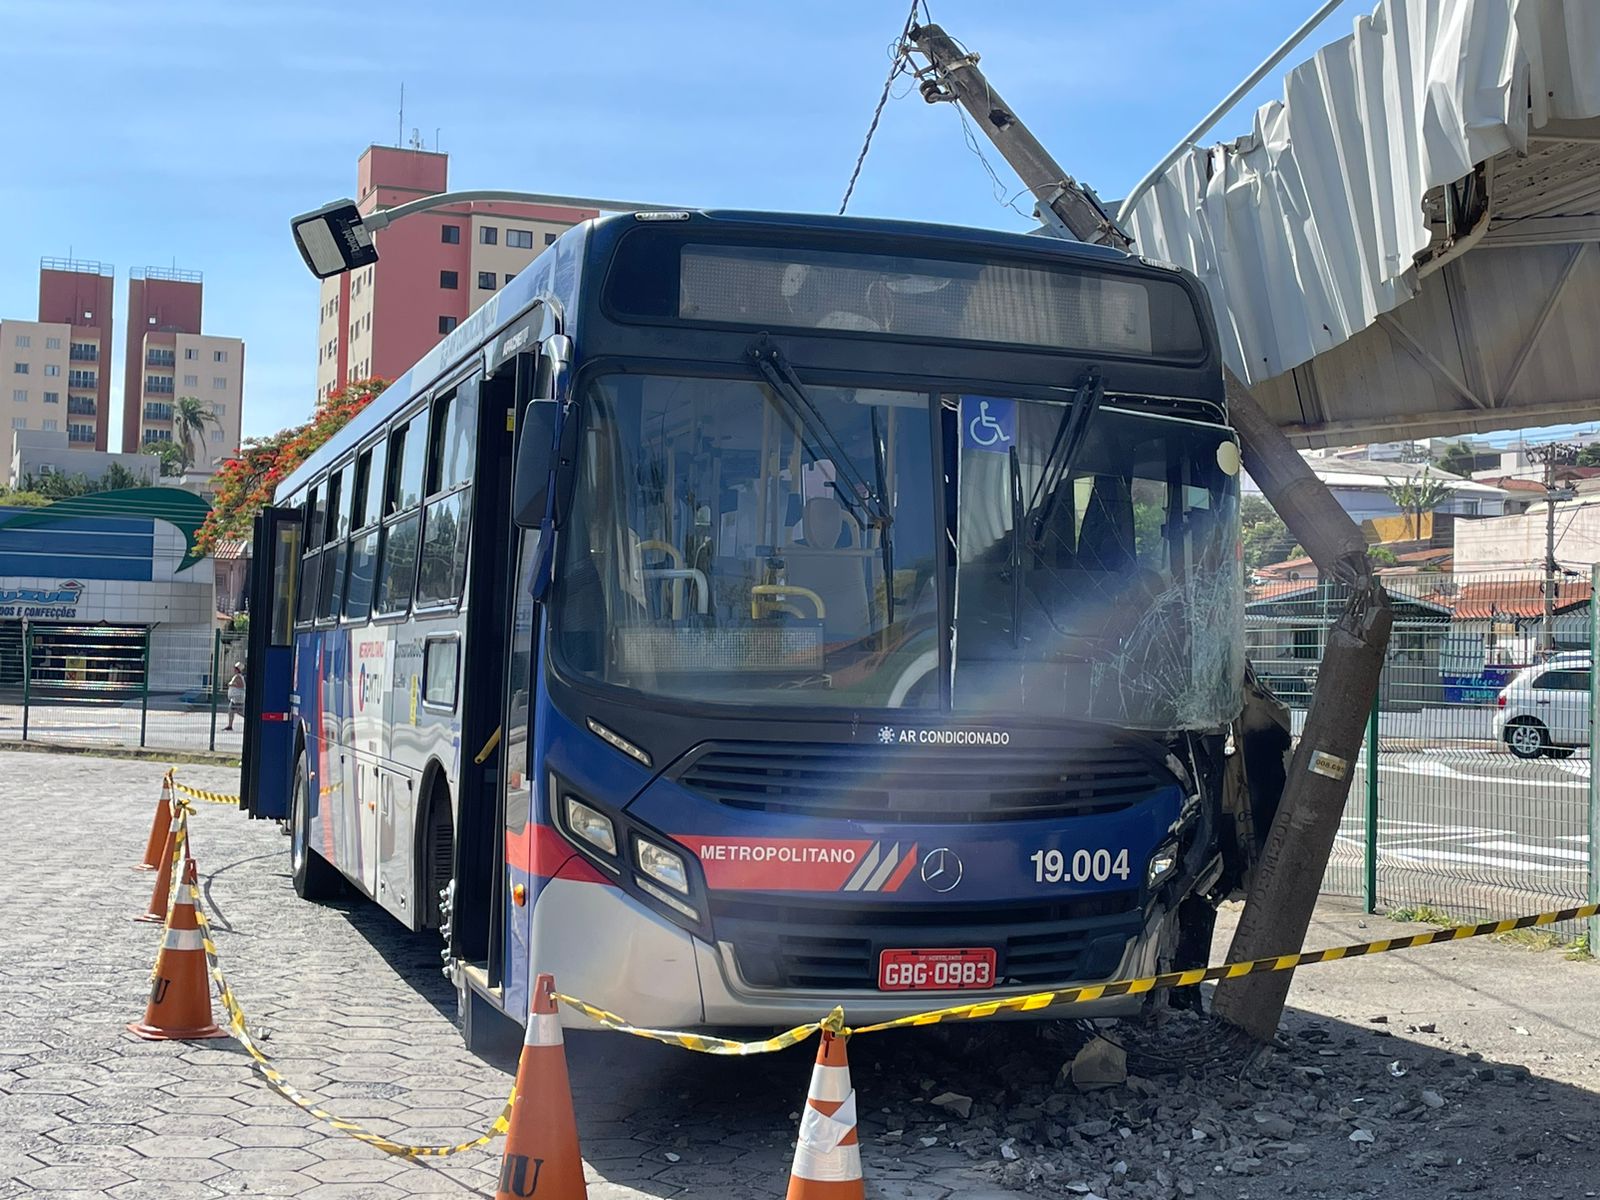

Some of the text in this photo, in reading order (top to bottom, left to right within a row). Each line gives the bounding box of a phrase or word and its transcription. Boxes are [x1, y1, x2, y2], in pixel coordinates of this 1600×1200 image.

[899, 729, 1010, 745] AR CONDICIONADO
[701, 845, 856, 863] METROPOLITANO
[1030, 848, 1130, 883] 19.004
